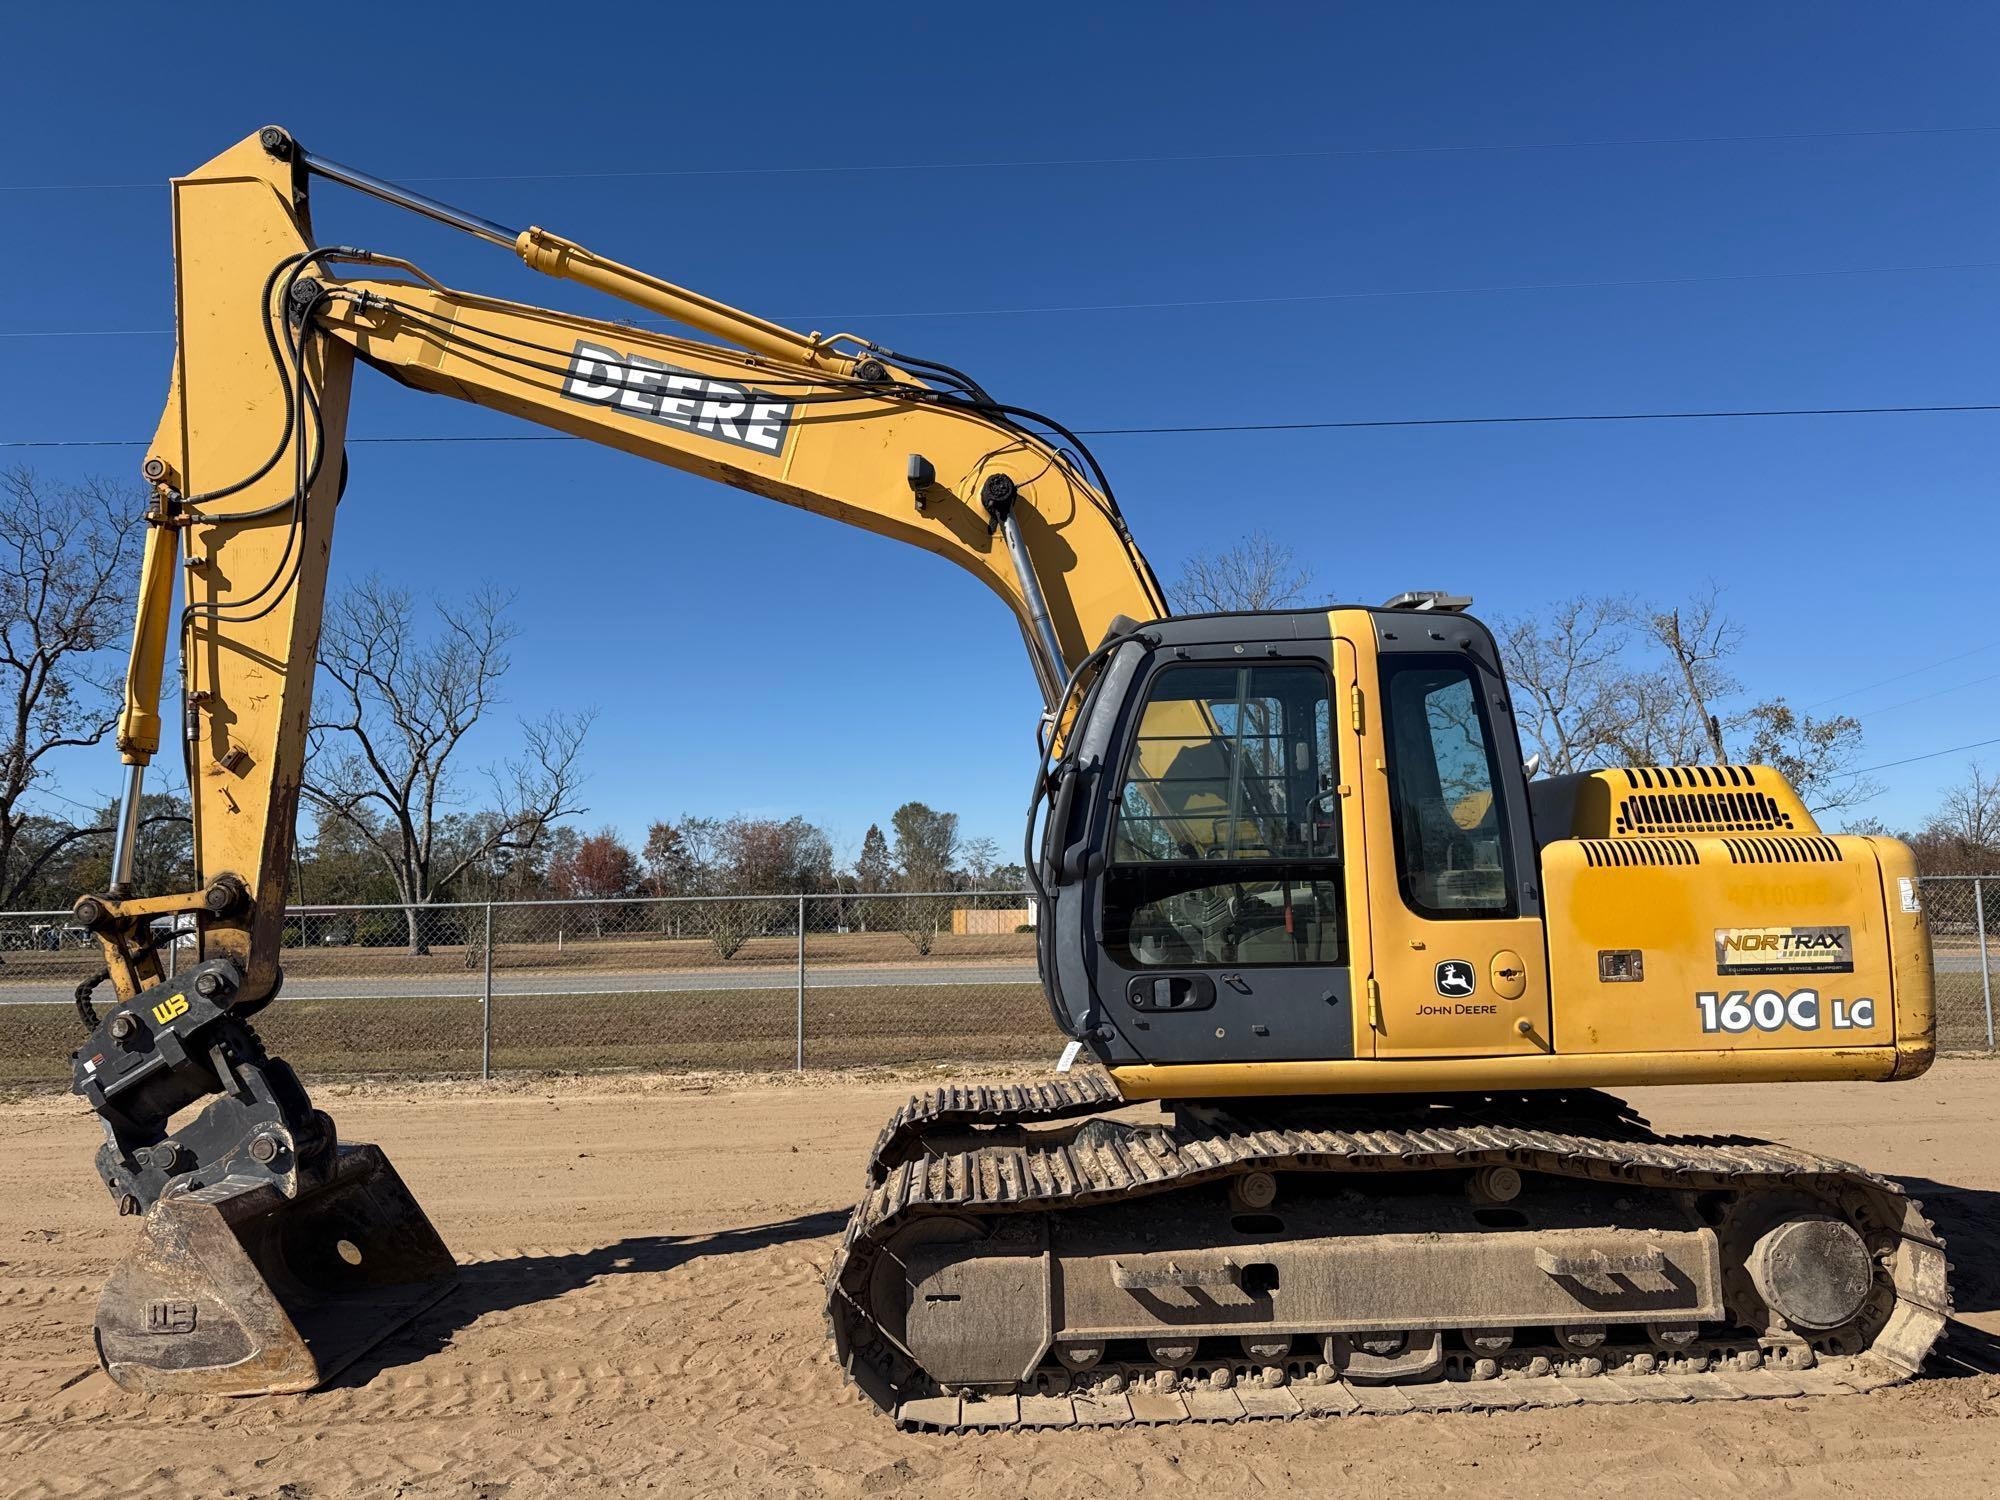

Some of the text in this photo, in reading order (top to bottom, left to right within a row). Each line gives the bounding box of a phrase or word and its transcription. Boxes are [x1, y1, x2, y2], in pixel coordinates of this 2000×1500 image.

[566, 346, 791, 451] DEERE
[1723, 933, 1844, 951] NORTRAX
[1416, 1004, 1497, 1015] JOHN DEERE
[1697, 989, 1874, 1033] 160C LC
